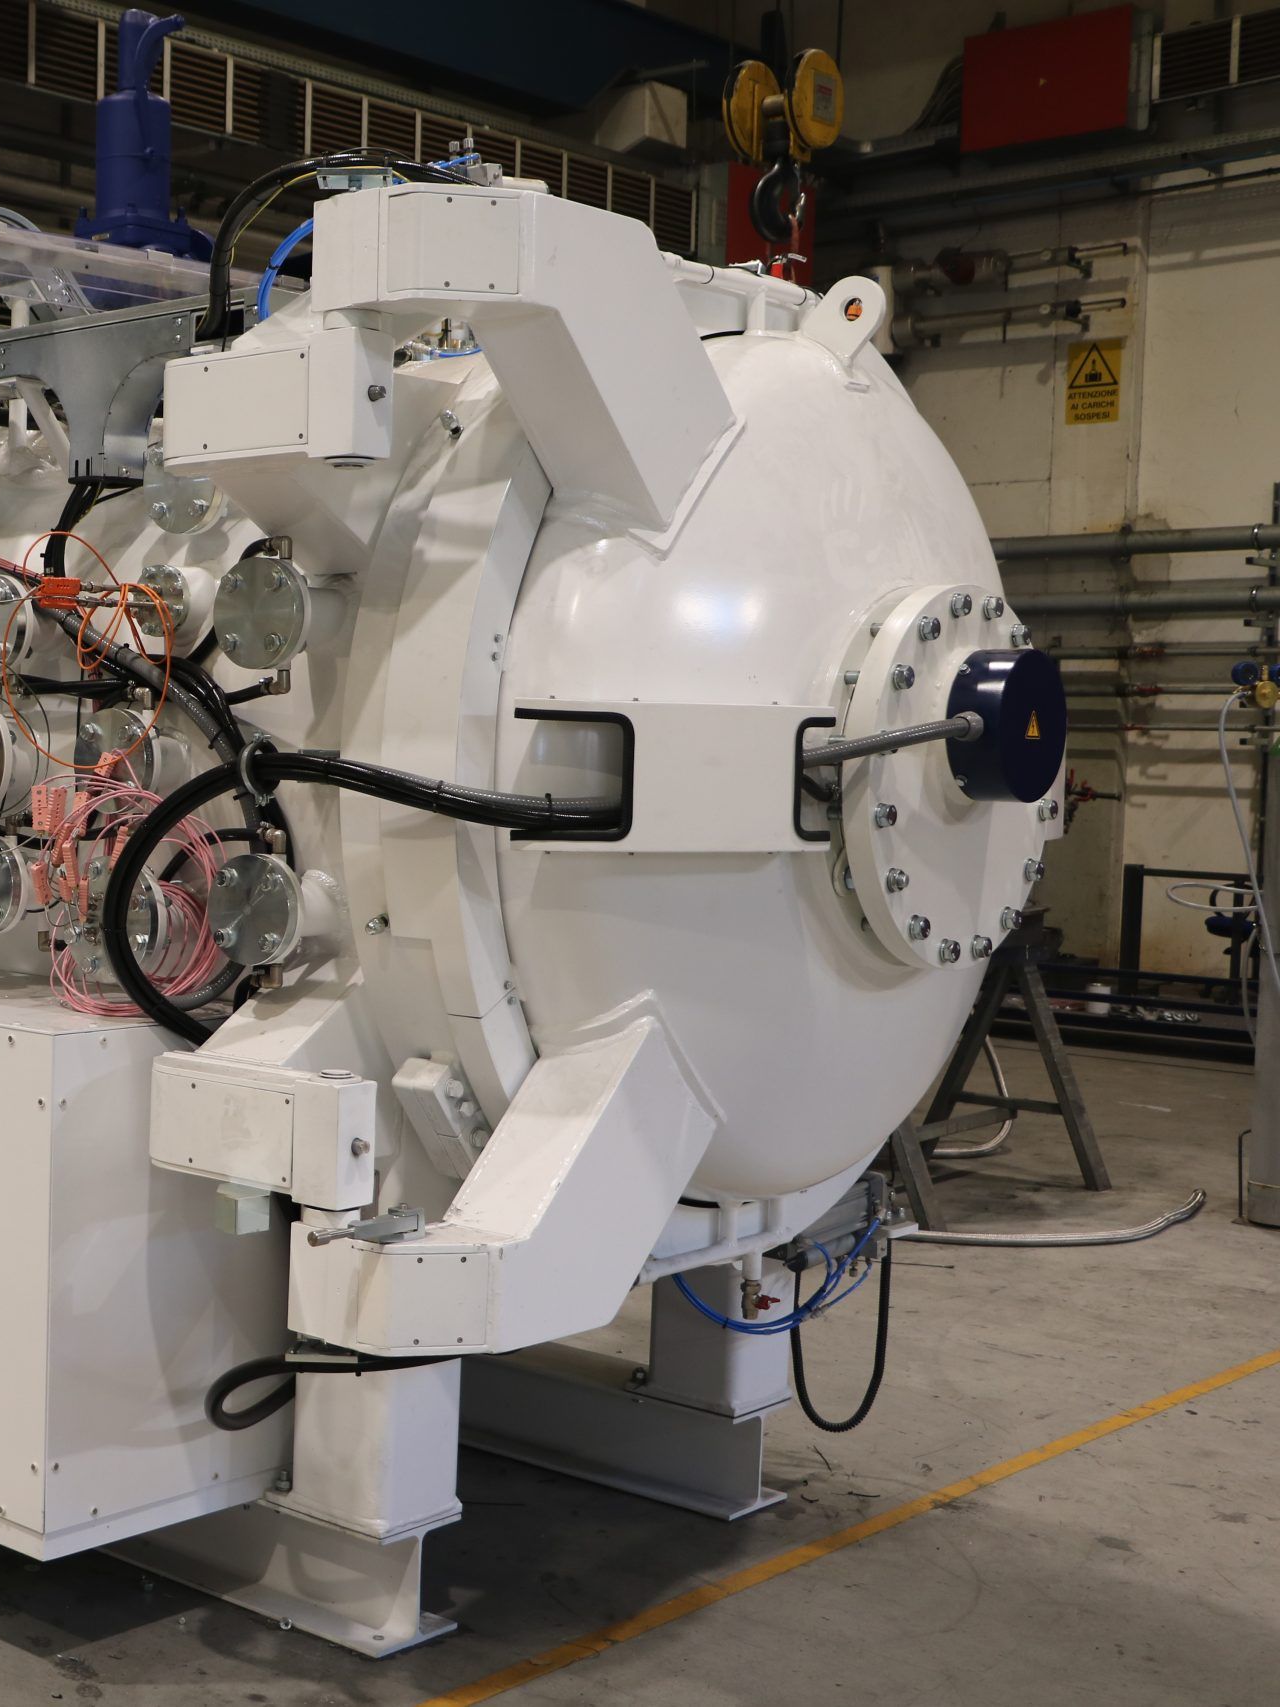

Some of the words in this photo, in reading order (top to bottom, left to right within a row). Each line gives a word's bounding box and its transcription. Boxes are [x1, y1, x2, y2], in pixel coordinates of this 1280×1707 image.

[1068, 390, 1118, 399] ATTENZIONE
[1081, 400, 1115, 410] CARICHI
[1074, 411, 1110, 421] SOSPESI
